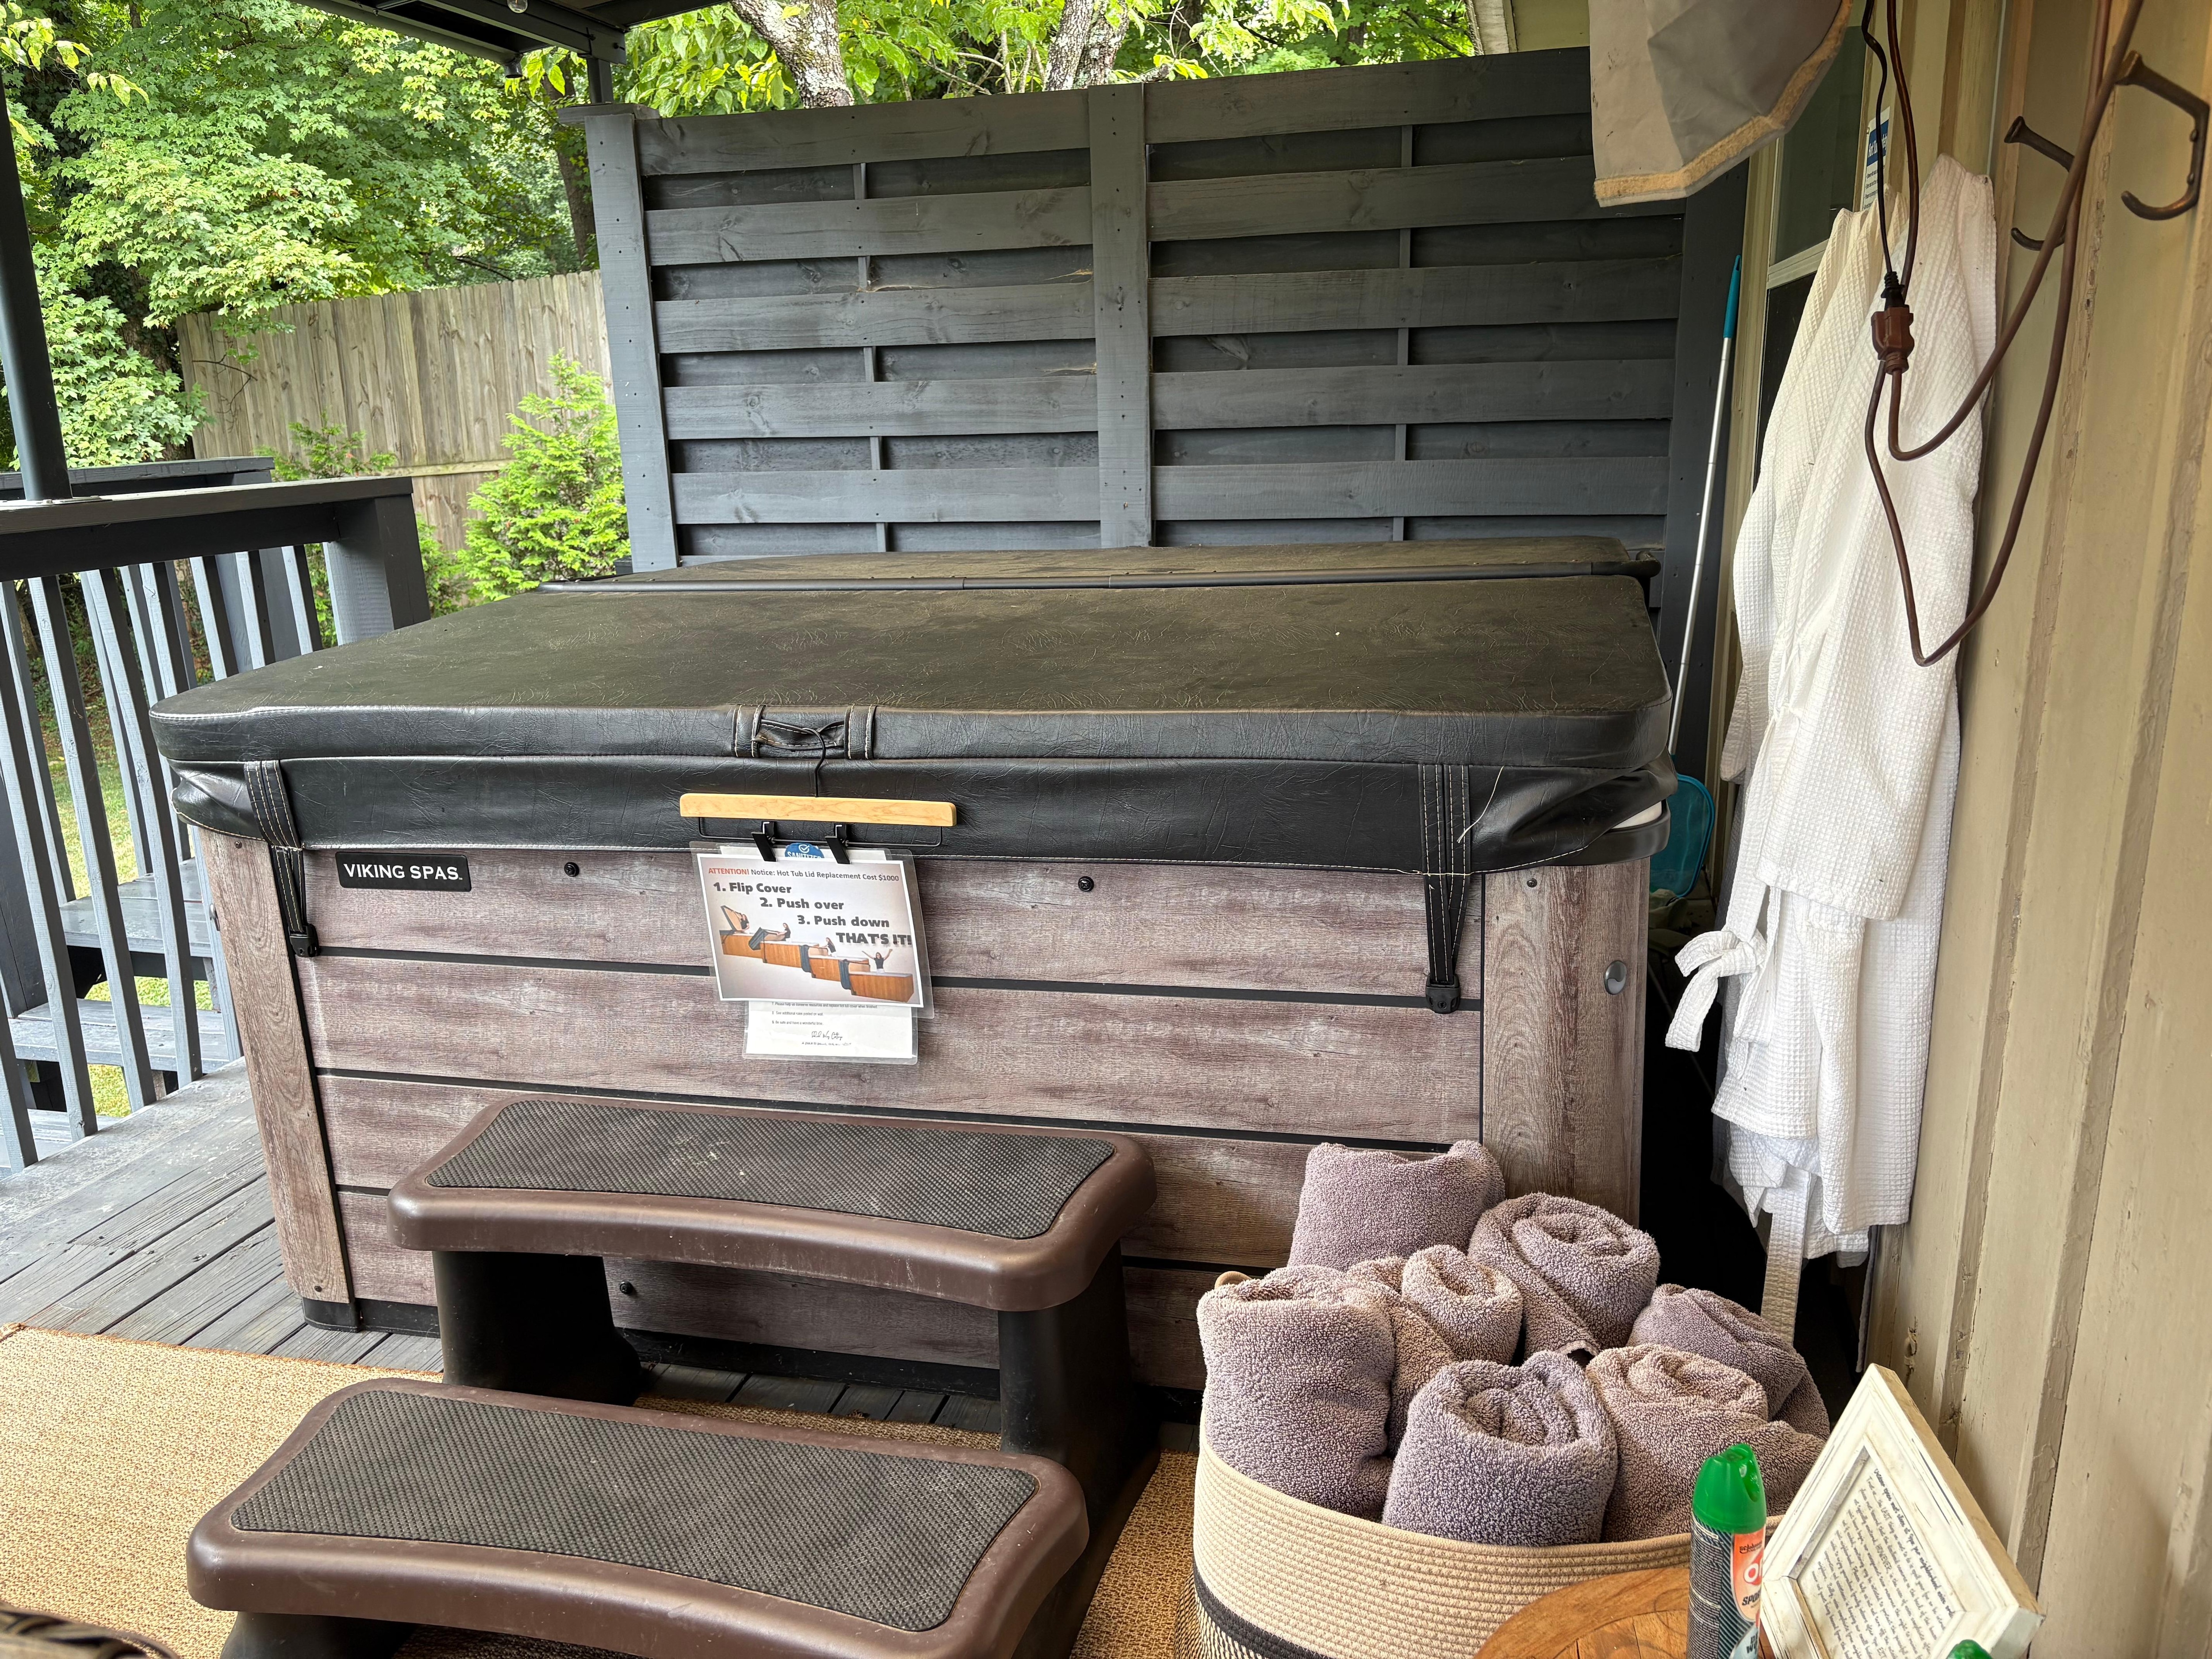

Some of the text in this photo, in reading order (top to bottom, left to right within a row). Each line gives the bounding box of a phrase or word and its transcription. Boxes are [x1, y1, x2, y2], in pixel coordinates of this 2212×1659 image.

[343, 863, 459, 880] VIKING SPAS
[713, 882, 791, 895] 1. Flip Cover
[760, 897, 772, 907] 2.
[777, 898, 810, 908] Push
[797, 915, 890, 927] 3. Push down
